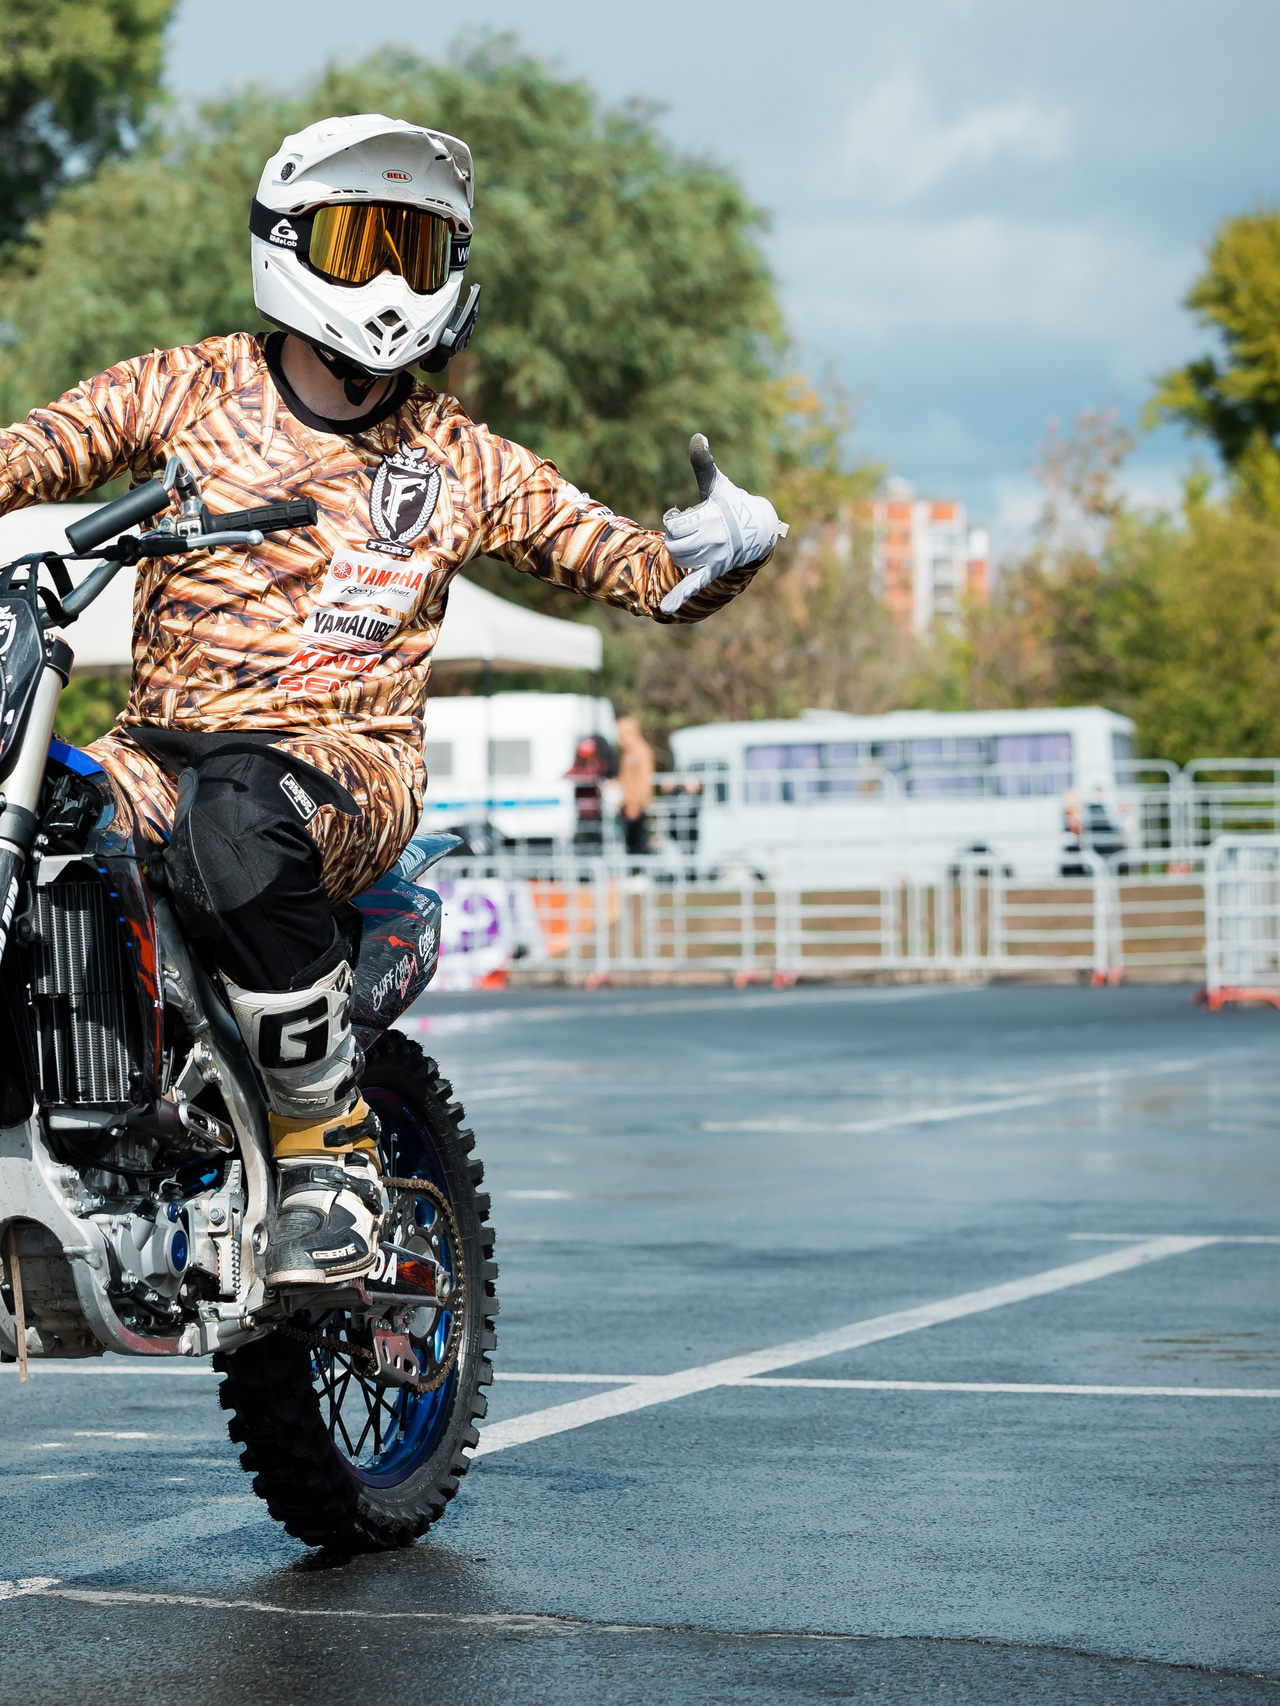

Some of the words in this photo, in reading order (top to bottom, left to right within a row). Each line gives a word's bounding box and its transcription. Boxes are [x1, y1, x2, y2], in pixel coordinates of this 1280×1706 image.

[386, 172, 409, 181] BELL
[356, 564, 424, 591] YAMAHA
[314, 612, 397, 643] YAMALUBE
[371, 972, 396, 1012] BUFF
